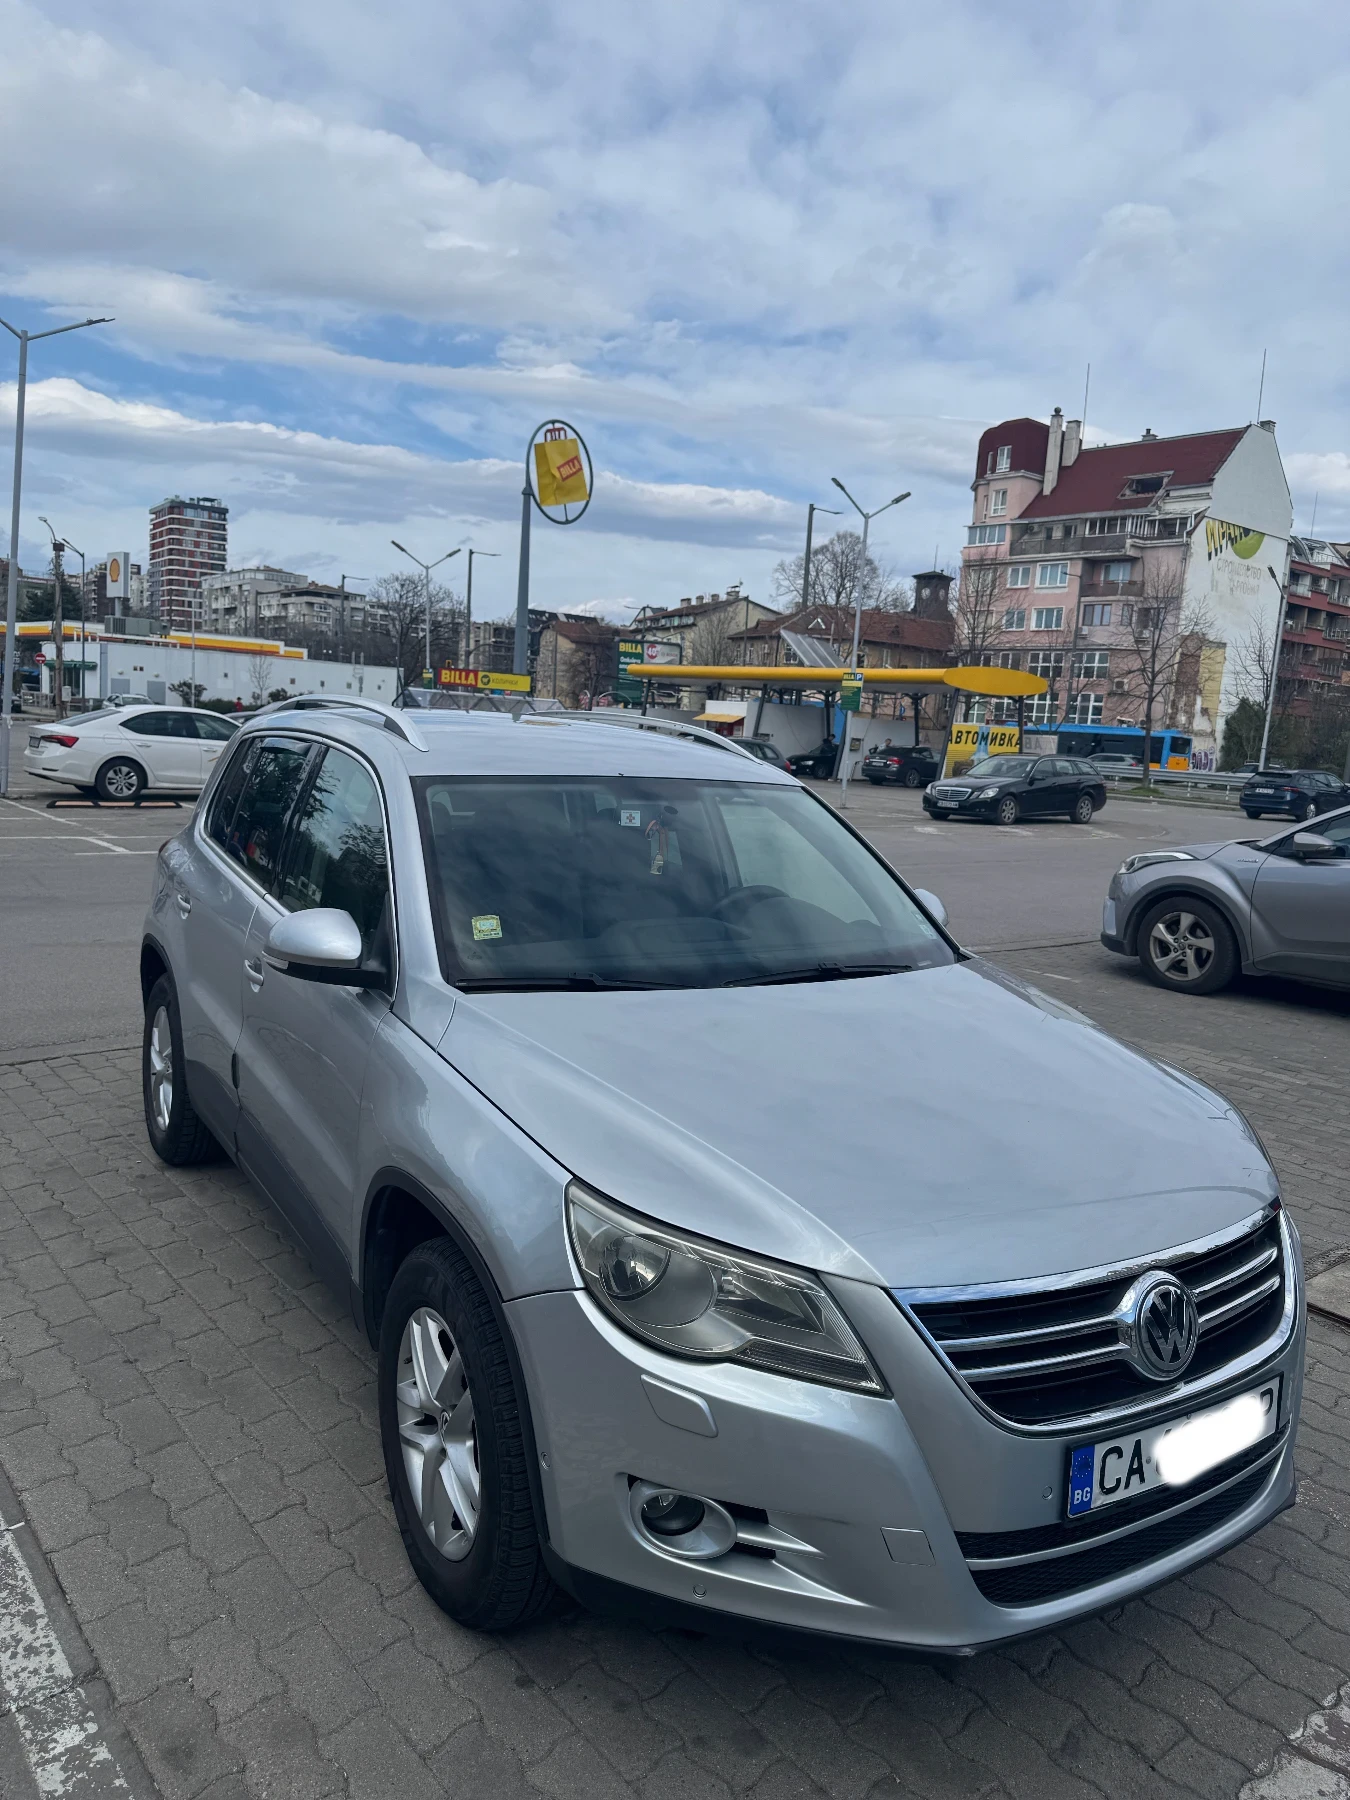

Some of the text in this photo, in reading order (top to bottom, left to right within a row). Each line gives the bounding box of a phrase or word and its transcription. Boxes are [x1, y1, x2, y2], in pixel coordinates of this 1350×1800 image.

[560, 461, 580, 478] BILLA
[619, 642, 642, 653] BILLA
[441, 670, 476, 685] BILLA
[948, 730, 1020, 748] АВТОМИВКА
[1099, 1438, 1146, 1496] CA
[1073, 1486, 1091, 1505] BG
